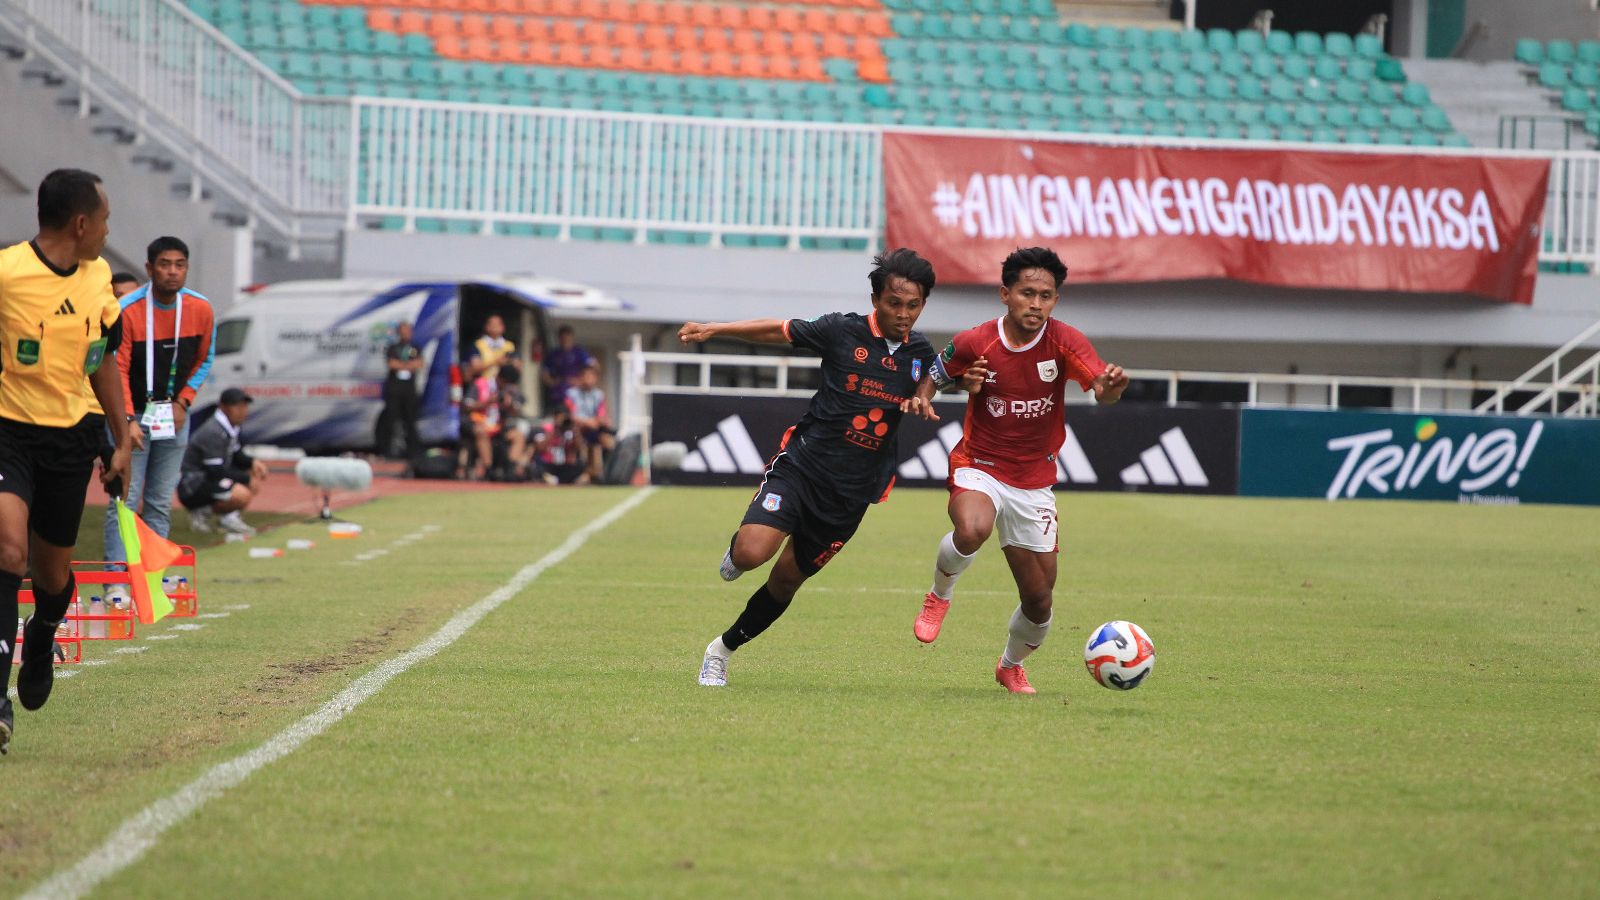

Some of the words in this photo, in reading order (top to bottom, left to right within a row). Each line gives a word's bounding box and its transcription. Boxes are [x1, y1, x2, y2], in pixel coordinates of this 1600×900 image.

[931, 172, 1500, 253] #AINGMANEHGARUDAYAKSA
[862, 378, 885, 391] BANK
[1010, 393, 1055, 414] DRX
[1015, 406, 1052, 419] TOKEN
[1042, 515, 1052, 536] 7
